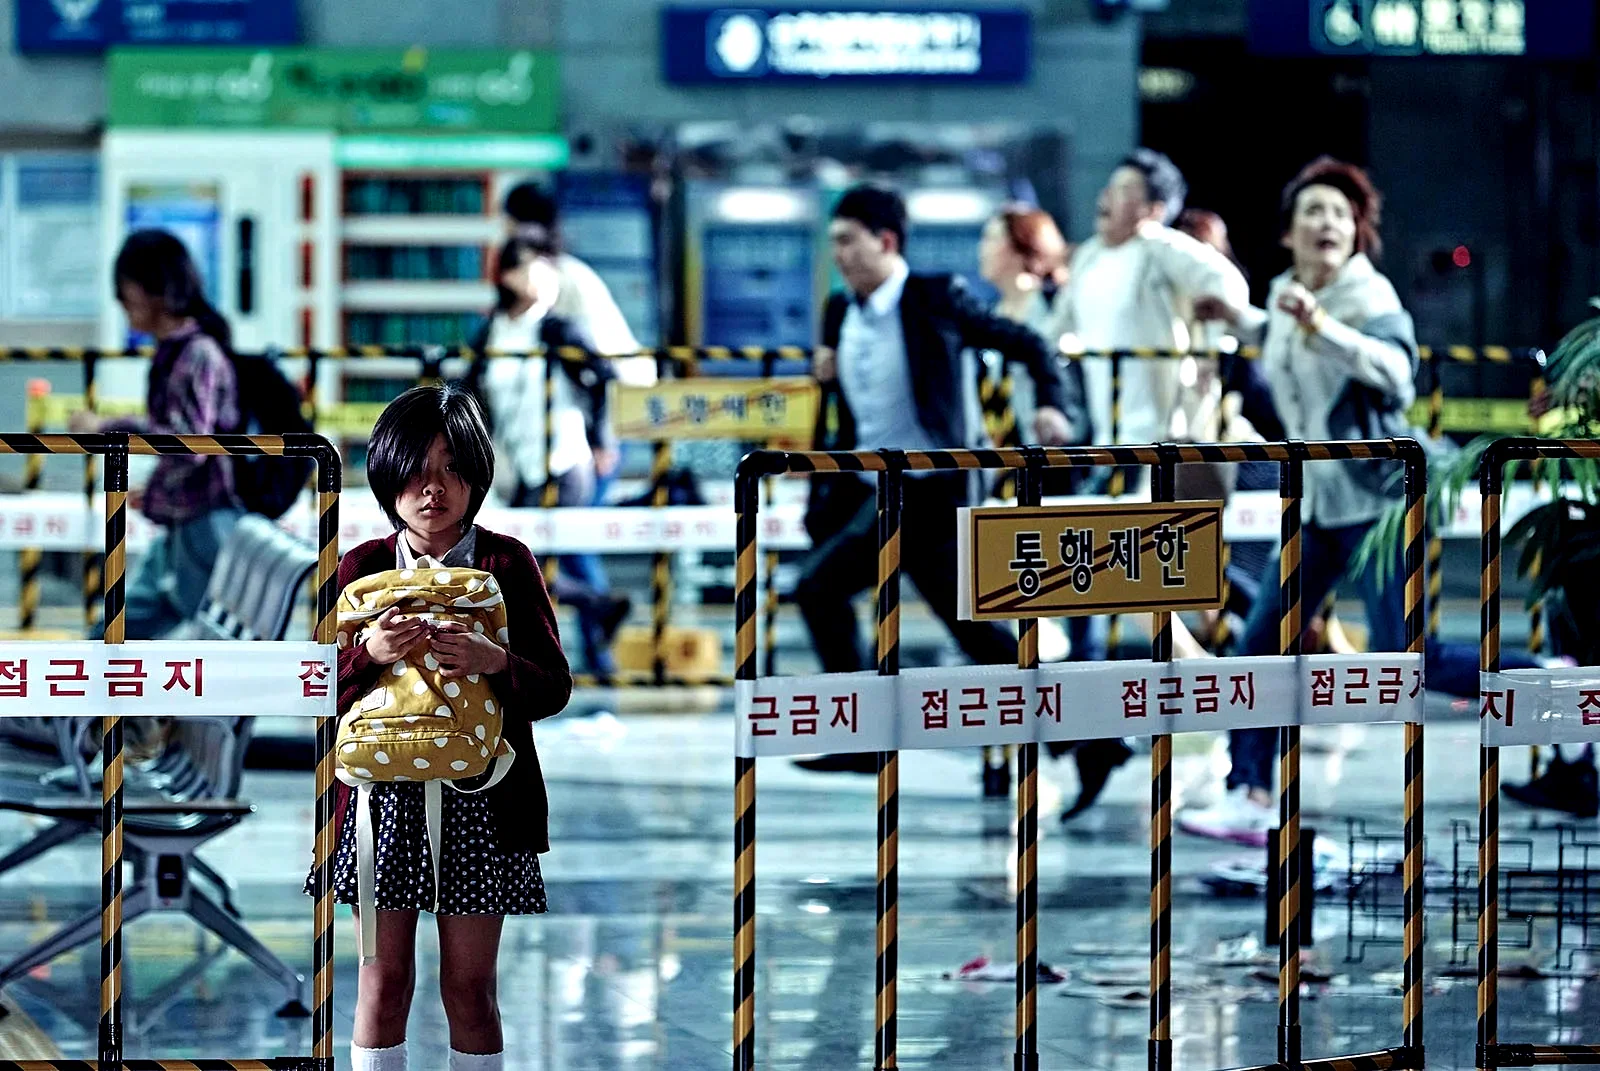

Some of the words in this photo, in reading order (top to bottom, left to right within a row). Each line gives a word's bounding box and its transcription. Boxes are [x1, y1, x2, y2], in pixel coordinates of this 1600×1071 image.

[1008, 524, 1190, 597] 통행제한
[748, 692, 858, 736] 근금지
[921, 683, 1062, 730] 접근금지
[1121, 672, 1255, 718] 접근금지
[1480, 689, 1515, 727] 지
